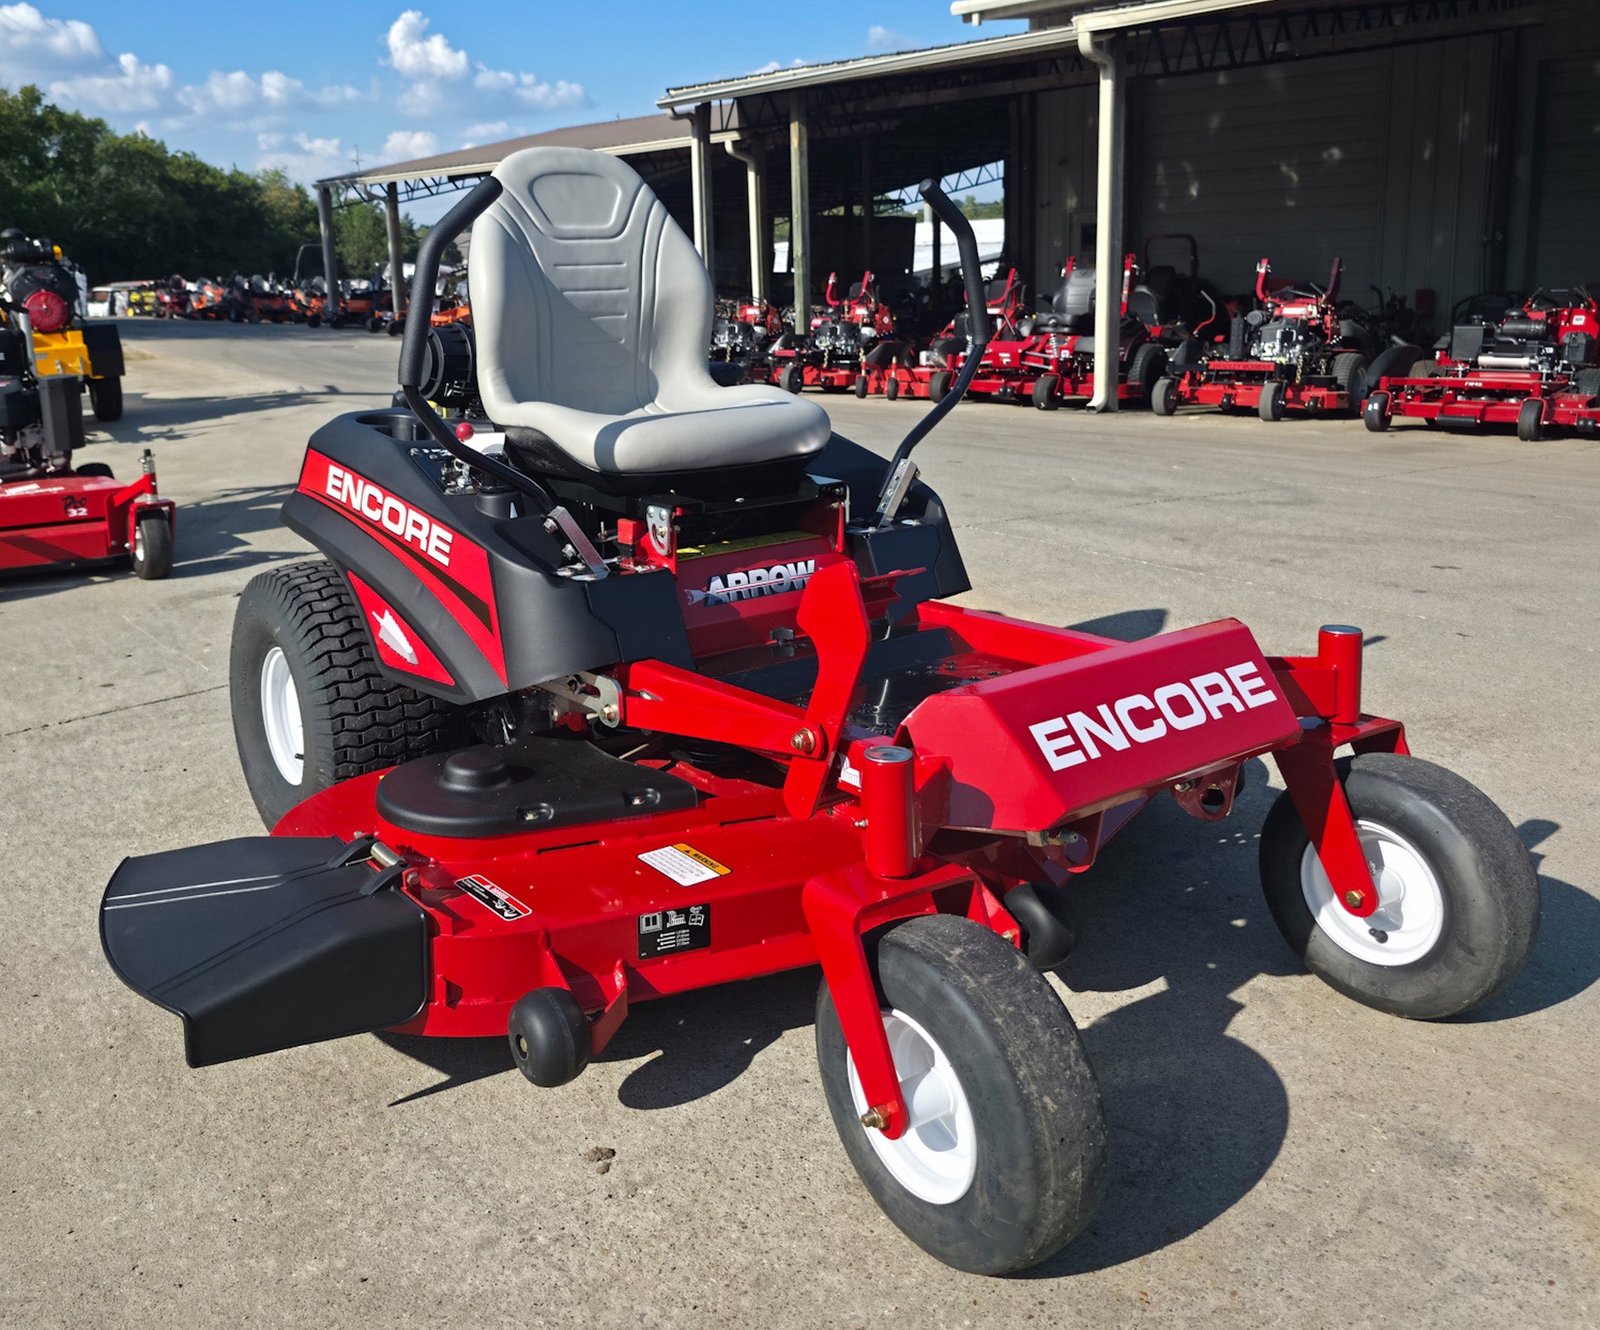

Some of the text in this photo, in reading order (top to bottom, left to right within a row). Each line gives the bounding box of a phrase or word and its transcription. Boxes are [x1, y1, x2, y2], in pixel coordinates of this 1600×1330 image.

[68, 507, 89, 517] 32
[325, 464, 453, 567] ENCORE
[707, 559, 816, 606] ARROW
[1028, 661, 1278, 772] ENCORE
